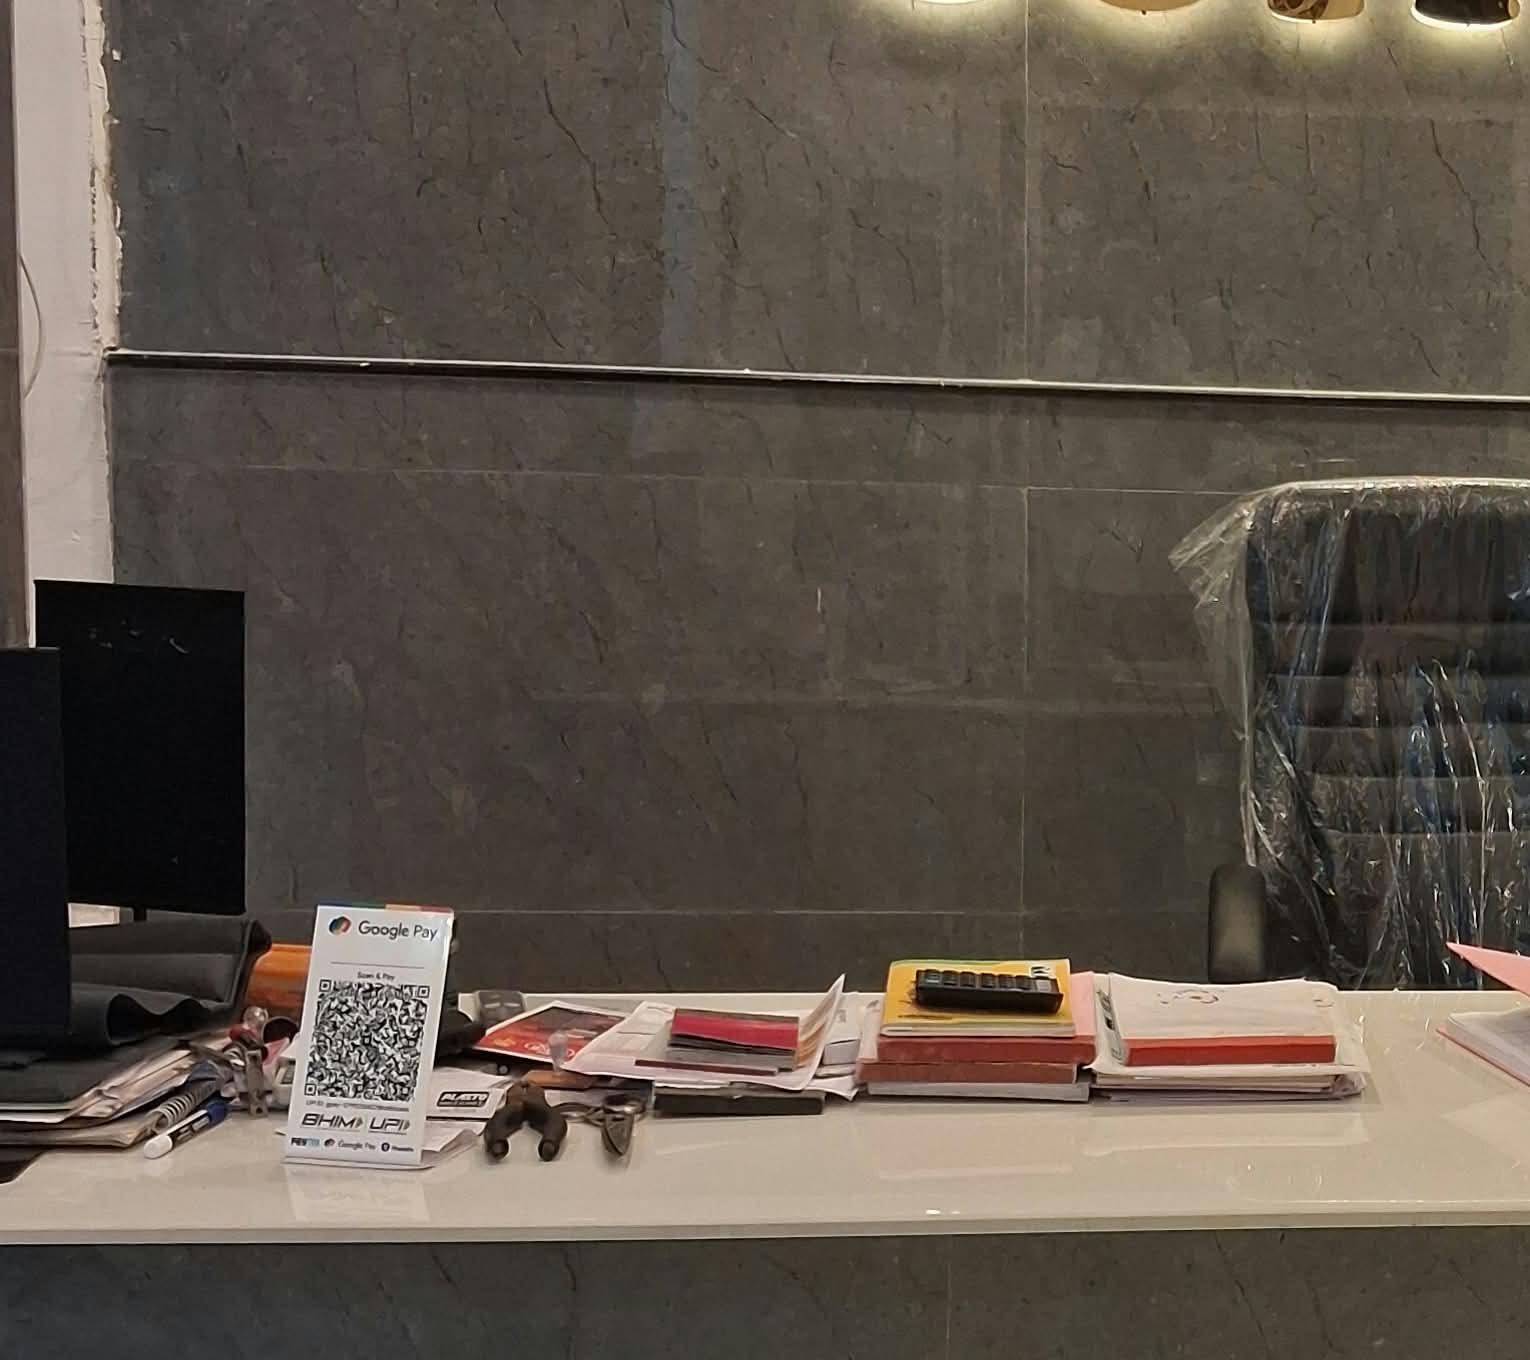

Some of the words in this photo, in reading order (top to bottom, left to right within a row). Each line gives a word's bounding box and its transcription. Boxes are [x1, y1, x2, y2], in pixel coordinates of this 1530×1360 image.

[357, 920, 409, 940] Google
[413, 924, 438, 942] Pay
[302, 1113, 355, 1128] BHIM
[370, 1117, 404, 1131] UPI
